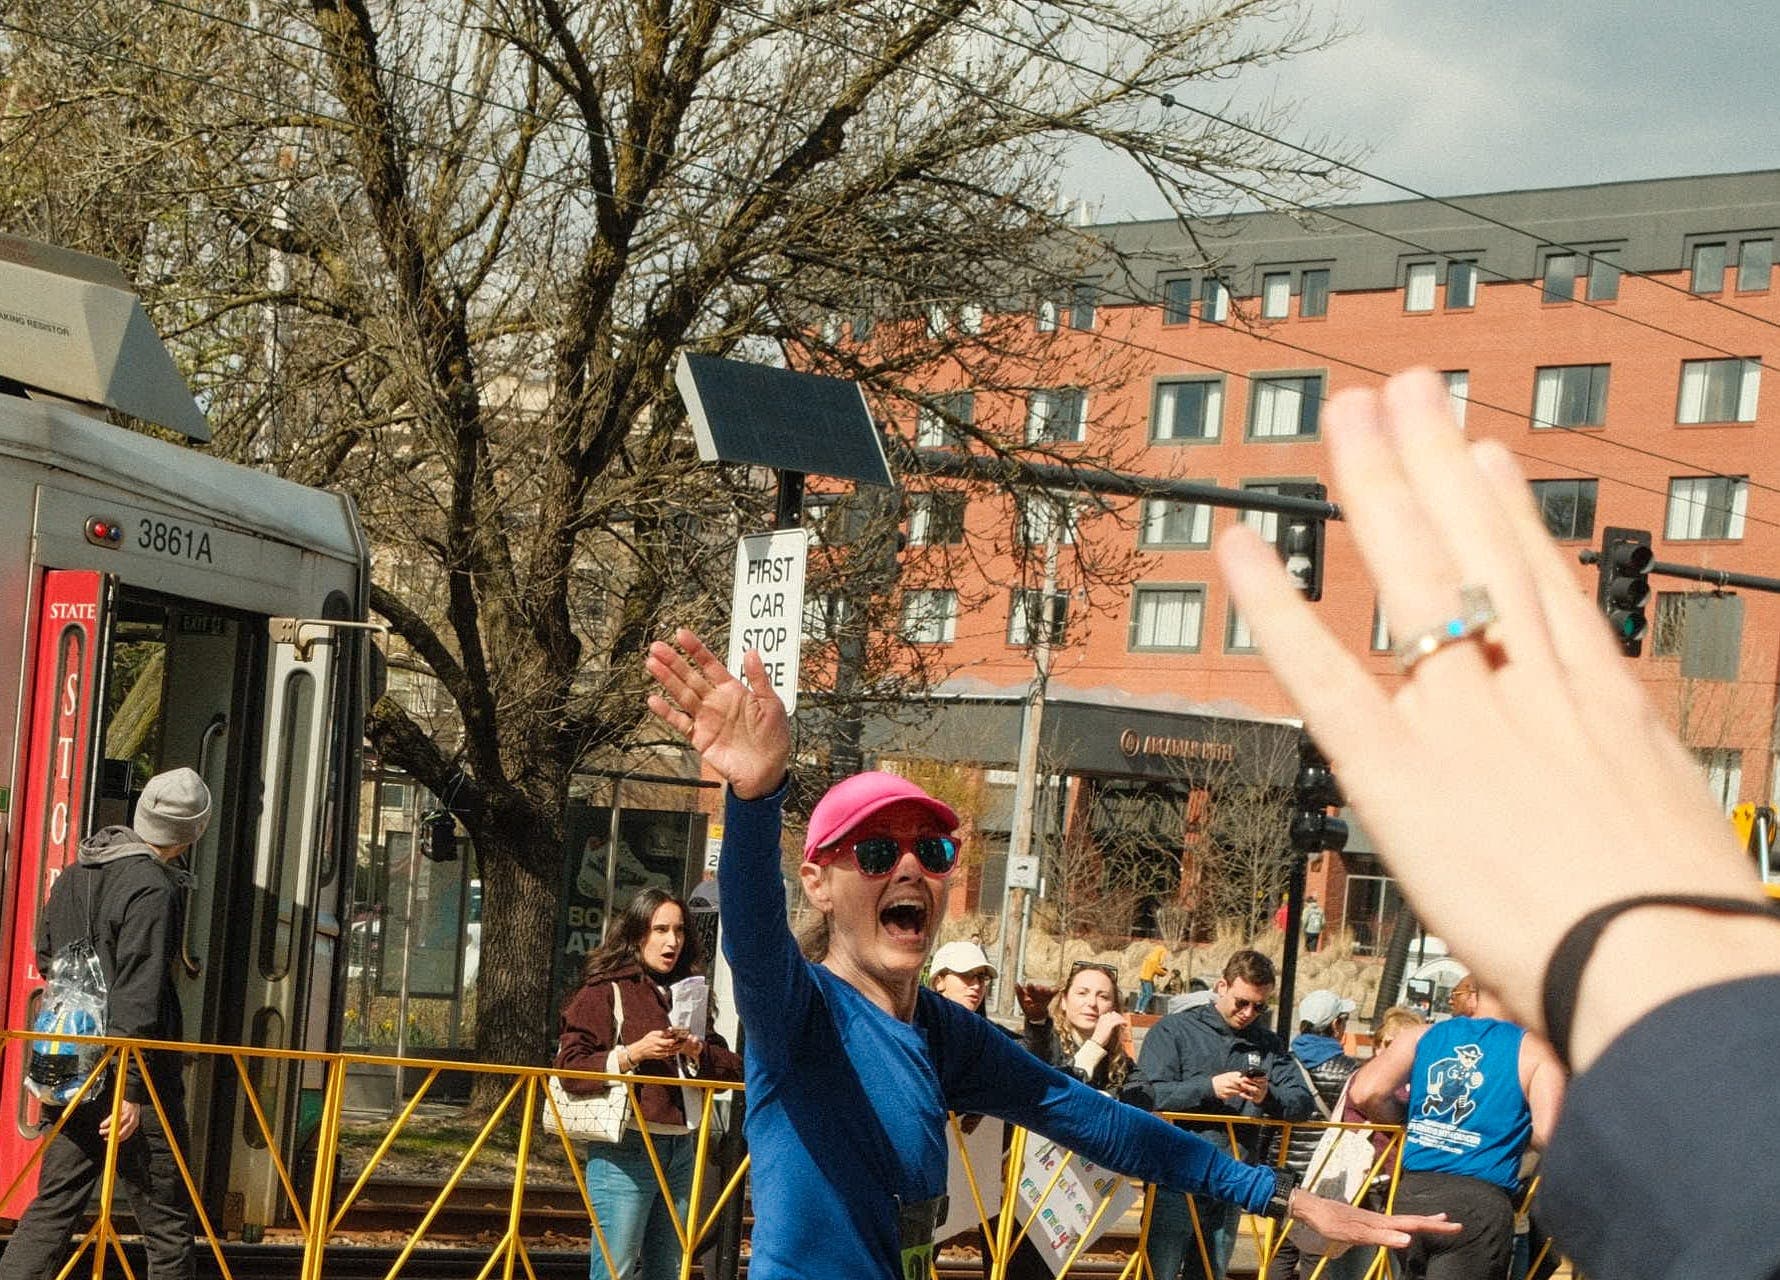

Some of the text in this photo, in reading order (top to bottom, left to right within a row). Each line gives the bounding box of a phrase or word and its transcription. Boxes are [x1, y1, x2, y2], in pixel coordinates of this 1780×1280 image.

[138, 518, 212, 564] 3861A
[747, 556, 794, 585] FIRST
[50, 602, 96, 620] STATE
[749, 592, 784, 619] CAR
[742, 627, 787, 653] STOP
[740, 662, 785, 687] HRE
